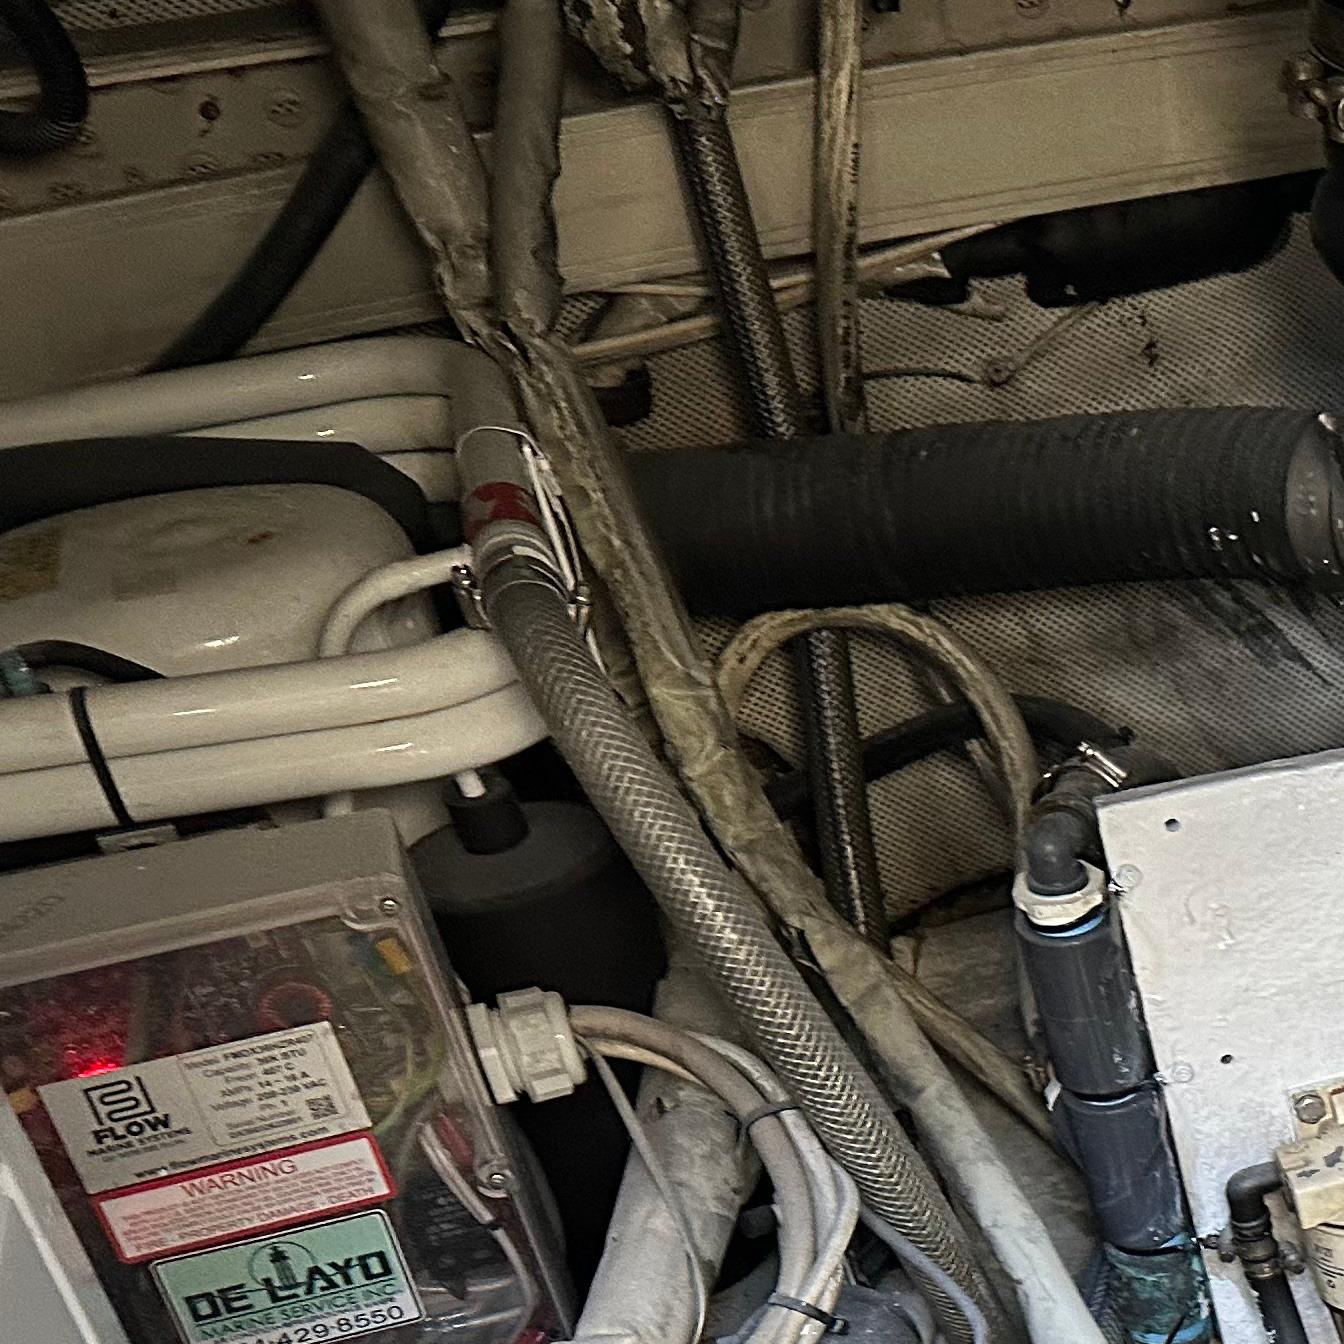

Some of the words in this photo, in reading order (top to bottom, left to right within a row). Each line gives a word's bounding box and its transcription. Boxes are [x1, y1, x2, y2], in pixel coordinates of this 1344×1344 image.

[92, 1113, 171, 1145] FLOW
[178, 1159, 299, 1198] WARNING
[184, 1282, 254, 1323] DE
[261, 1250, 394, 1305] LAYO
[198, 1309, 278, 1340] MARINE
[278, 1292, 356, 1320] SERVICE
